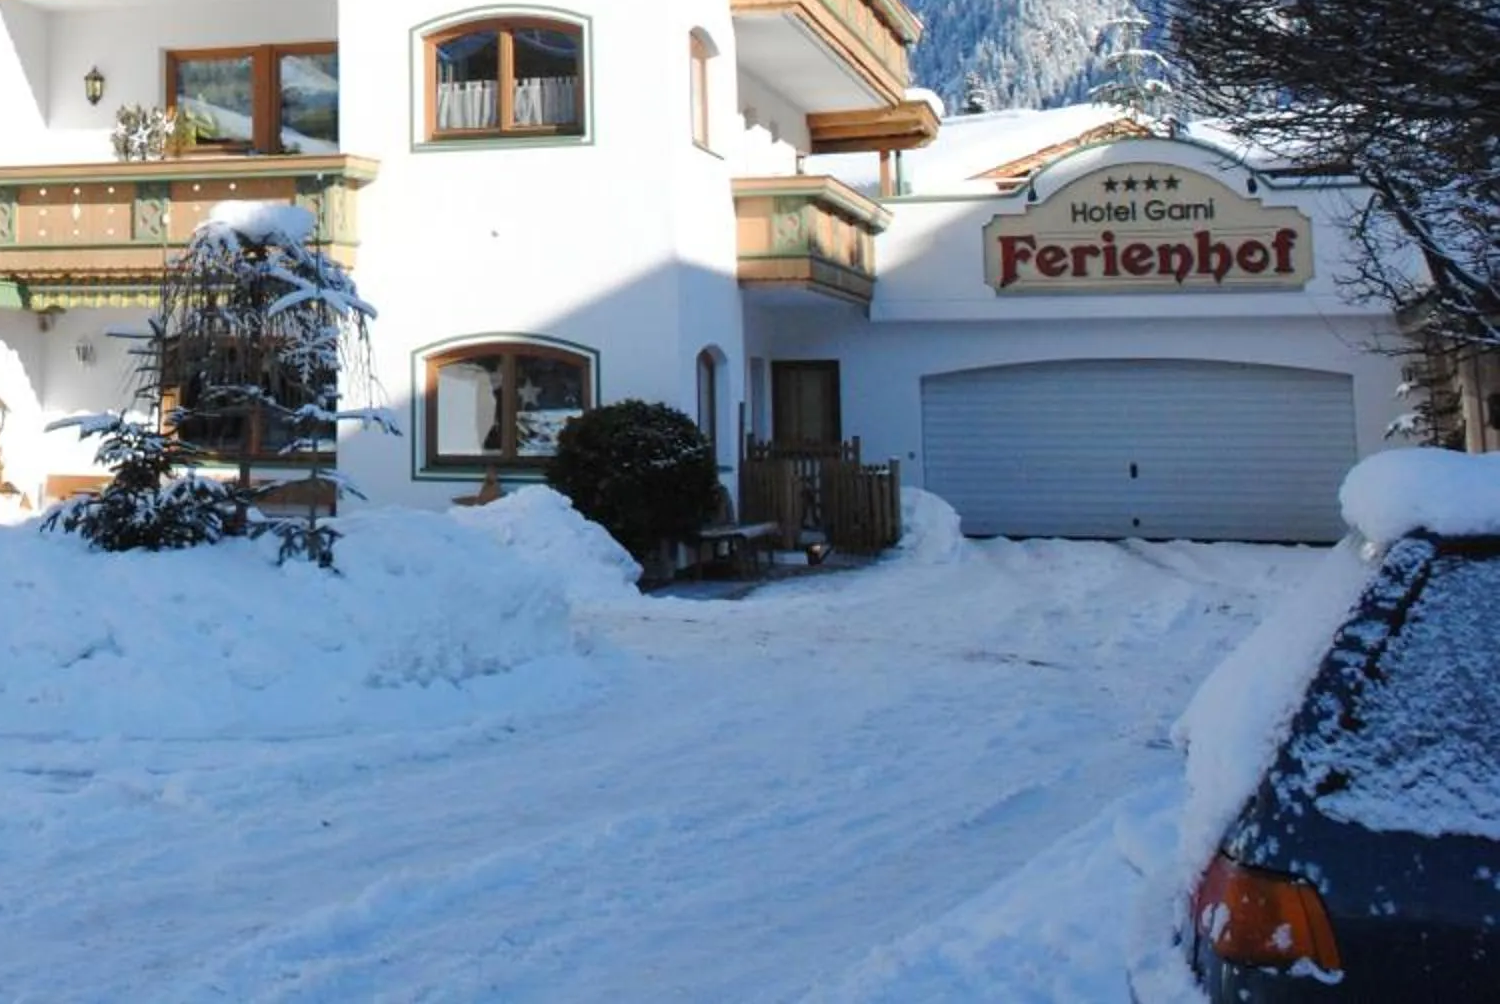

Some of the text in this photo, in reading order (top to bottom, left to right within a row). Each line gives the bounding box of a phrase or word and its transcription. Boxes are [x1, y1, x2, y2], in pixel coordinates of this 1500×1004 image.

[1071, 197, 1216, 223] Hotel Garni
[997, 227, 1299, 288] Ferienhof
